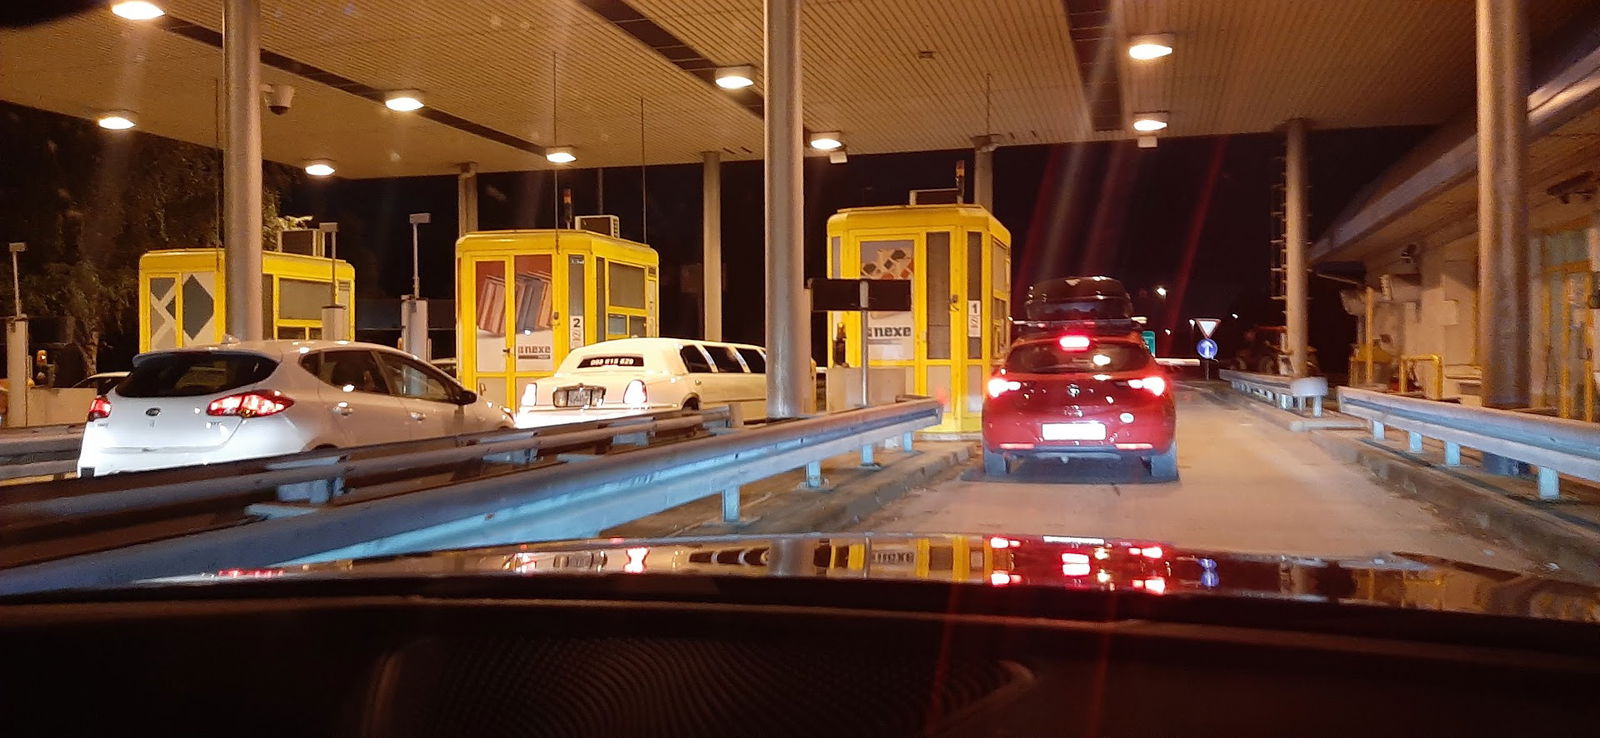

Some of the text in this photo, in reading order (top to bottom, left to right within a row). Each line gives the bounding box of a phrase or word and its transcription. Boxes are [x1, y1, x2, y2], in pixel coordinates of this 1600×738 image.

[971, 303, 978, 313] 1
[573, 318, 581, 328] 2
[874, 326, 912, 337] nexe
[525, 345, 551, 354] nexe
